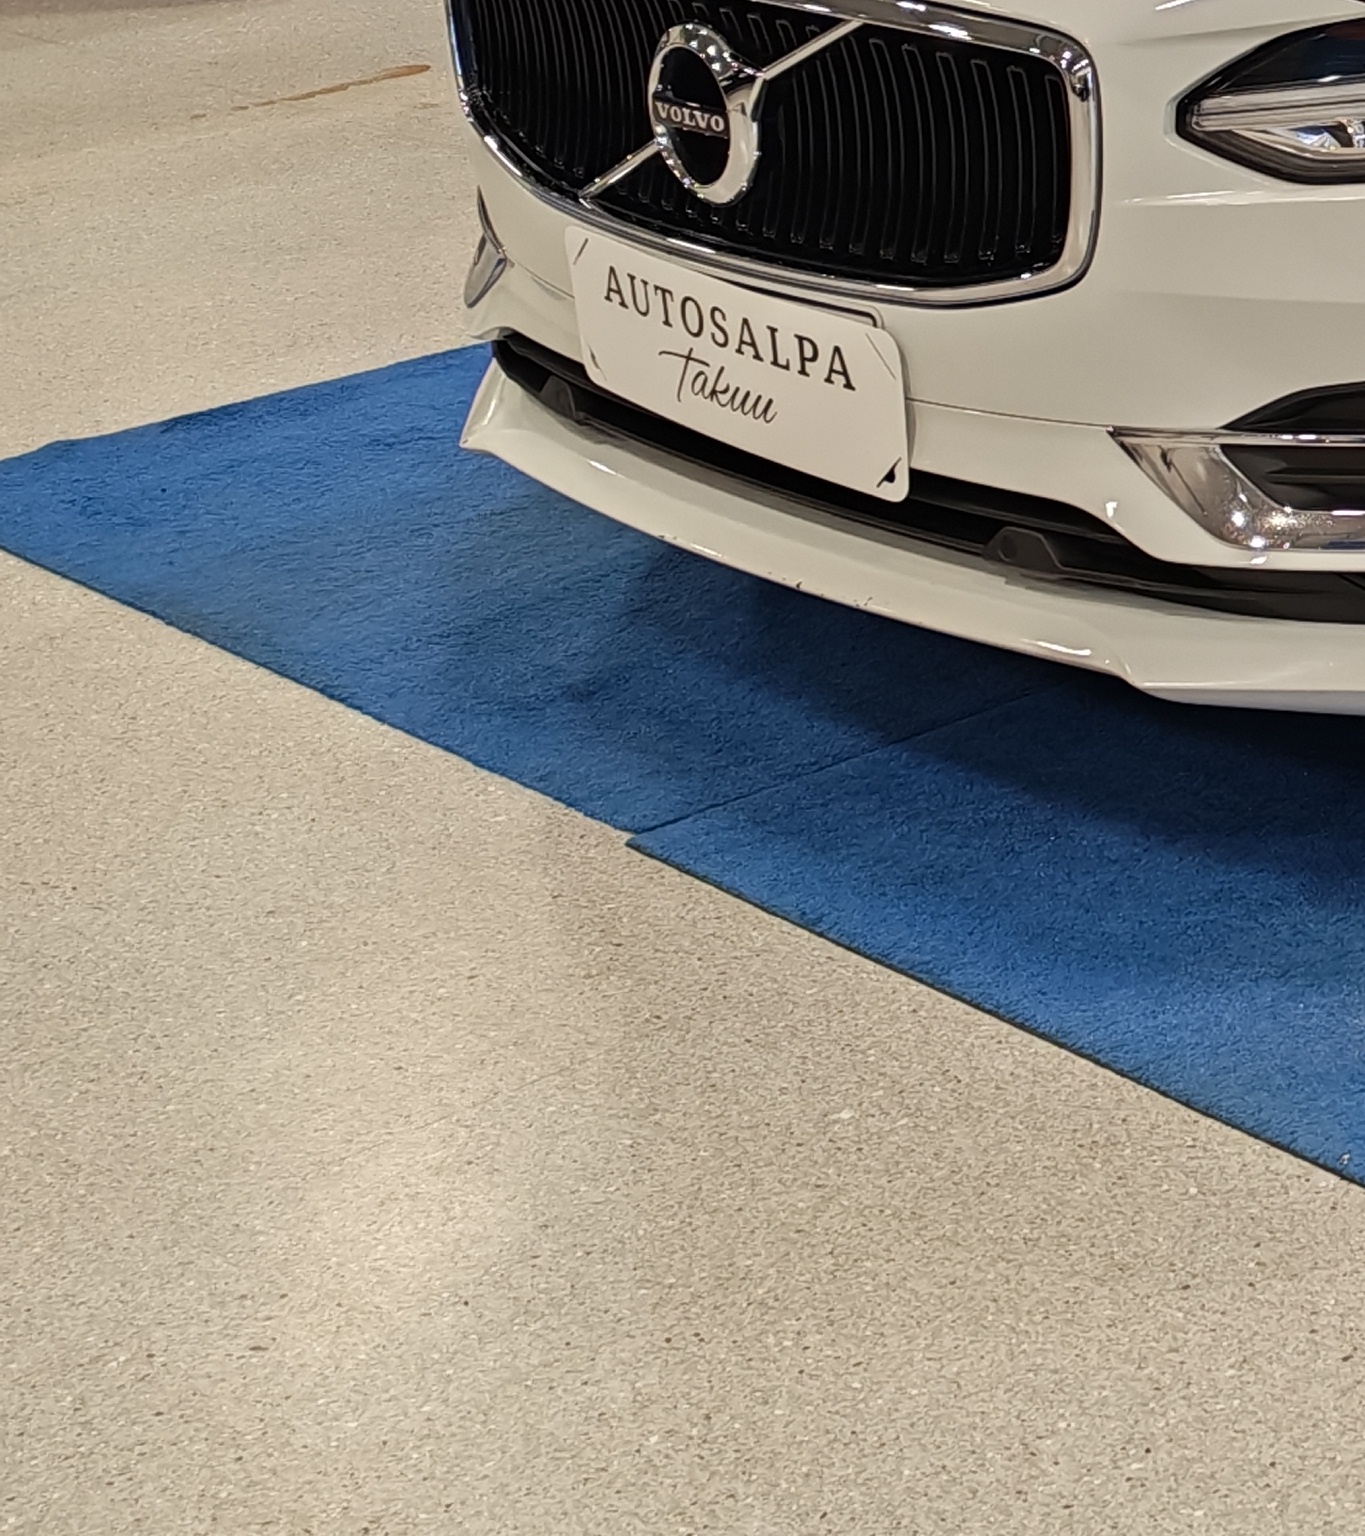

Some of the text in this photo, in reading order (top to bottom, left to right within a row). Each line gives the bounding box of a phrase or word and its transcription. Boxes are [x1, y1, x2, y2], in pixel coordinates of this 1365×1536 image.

[654, 101, 725, 132] VOLVO
[604, 265, 857, 392] AUTOSALPA
[658, 346, 777, 424] Takuu
